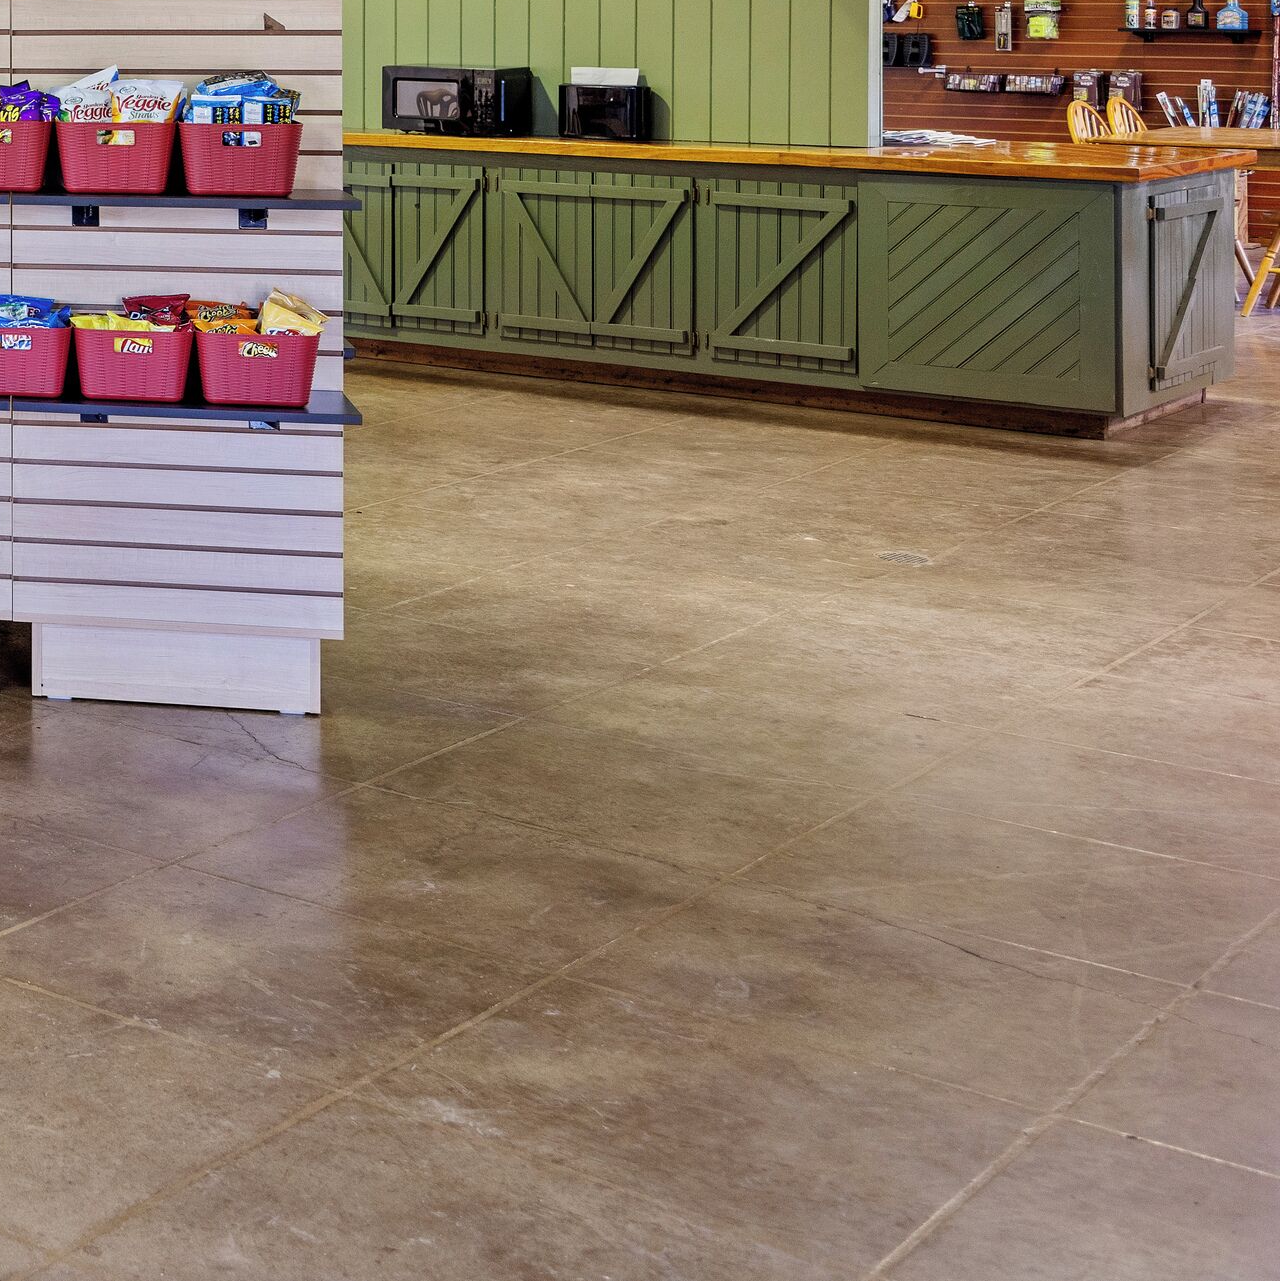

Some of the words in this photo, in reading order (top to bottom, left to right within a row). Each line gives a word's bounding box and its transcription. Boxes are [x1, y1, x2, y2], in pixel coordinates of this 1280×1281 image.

[64, 104, 112, 122] Veggie
[116, 95, 172, 113] Veggie
[128, 110, 159, 120] Straws
